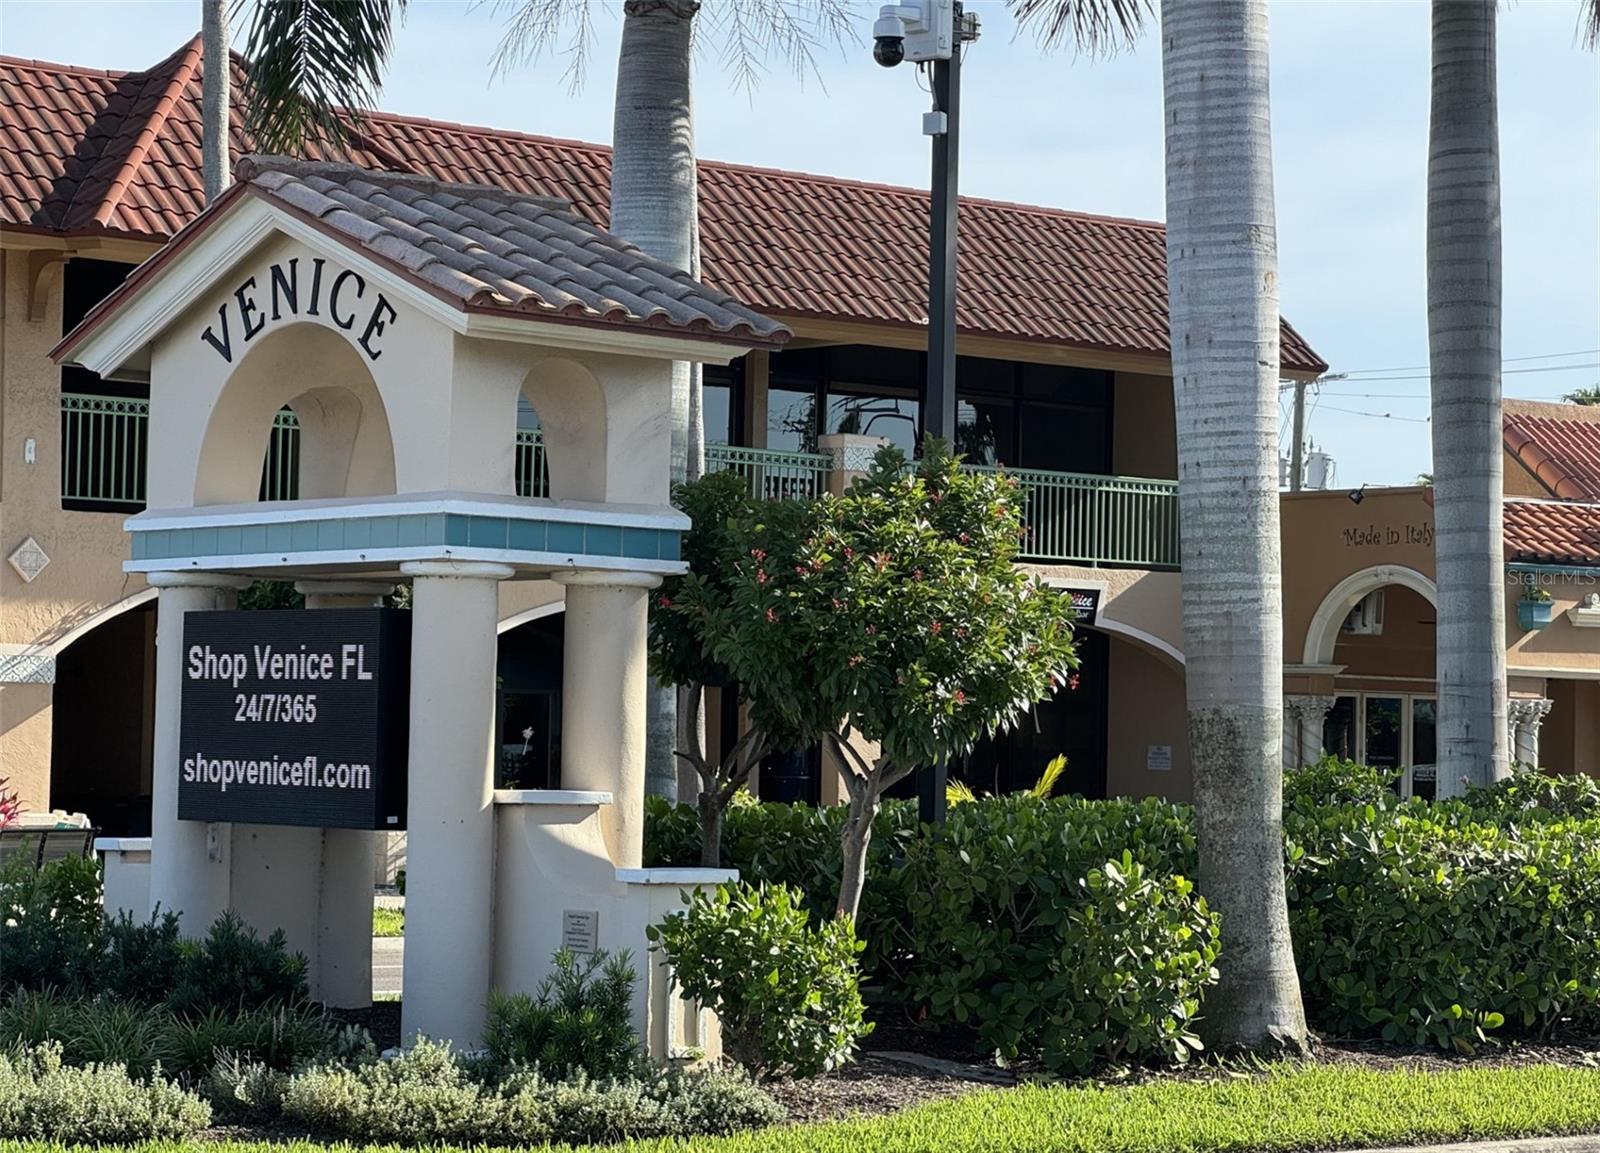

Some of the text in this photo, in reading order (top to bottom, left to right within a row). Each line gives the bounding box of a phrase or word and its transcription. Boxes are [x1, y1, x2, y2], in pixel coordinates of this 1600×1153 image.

[201, 257, 397, 363] VENICE
[1343, 522, 1435, 547] Made in Italy
[188, 644, 373, 688] Shop Venice FL
[234, 693, 317, 723] 24/7/365
[183, 752, 371, 792] shopvenicefl.com
